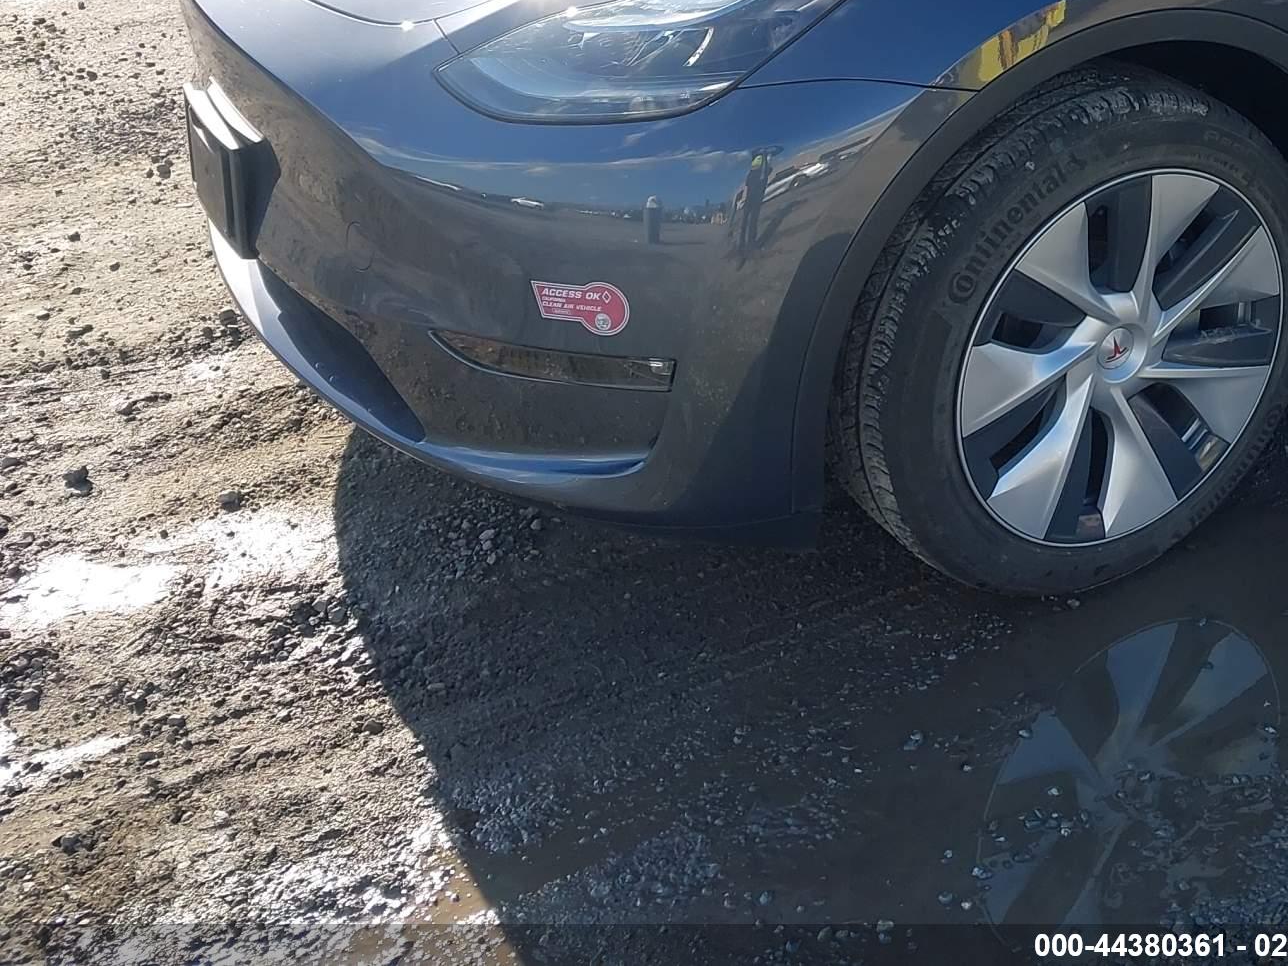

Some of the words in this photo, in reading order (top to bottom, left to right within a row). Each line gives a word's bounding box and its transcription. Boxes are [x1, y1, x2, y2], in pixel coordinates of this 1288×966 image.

[948, 161, 1069, 304] Continental
[541, 286, 582, 299] ACCESS
[585, 292, 602, 300] OK
